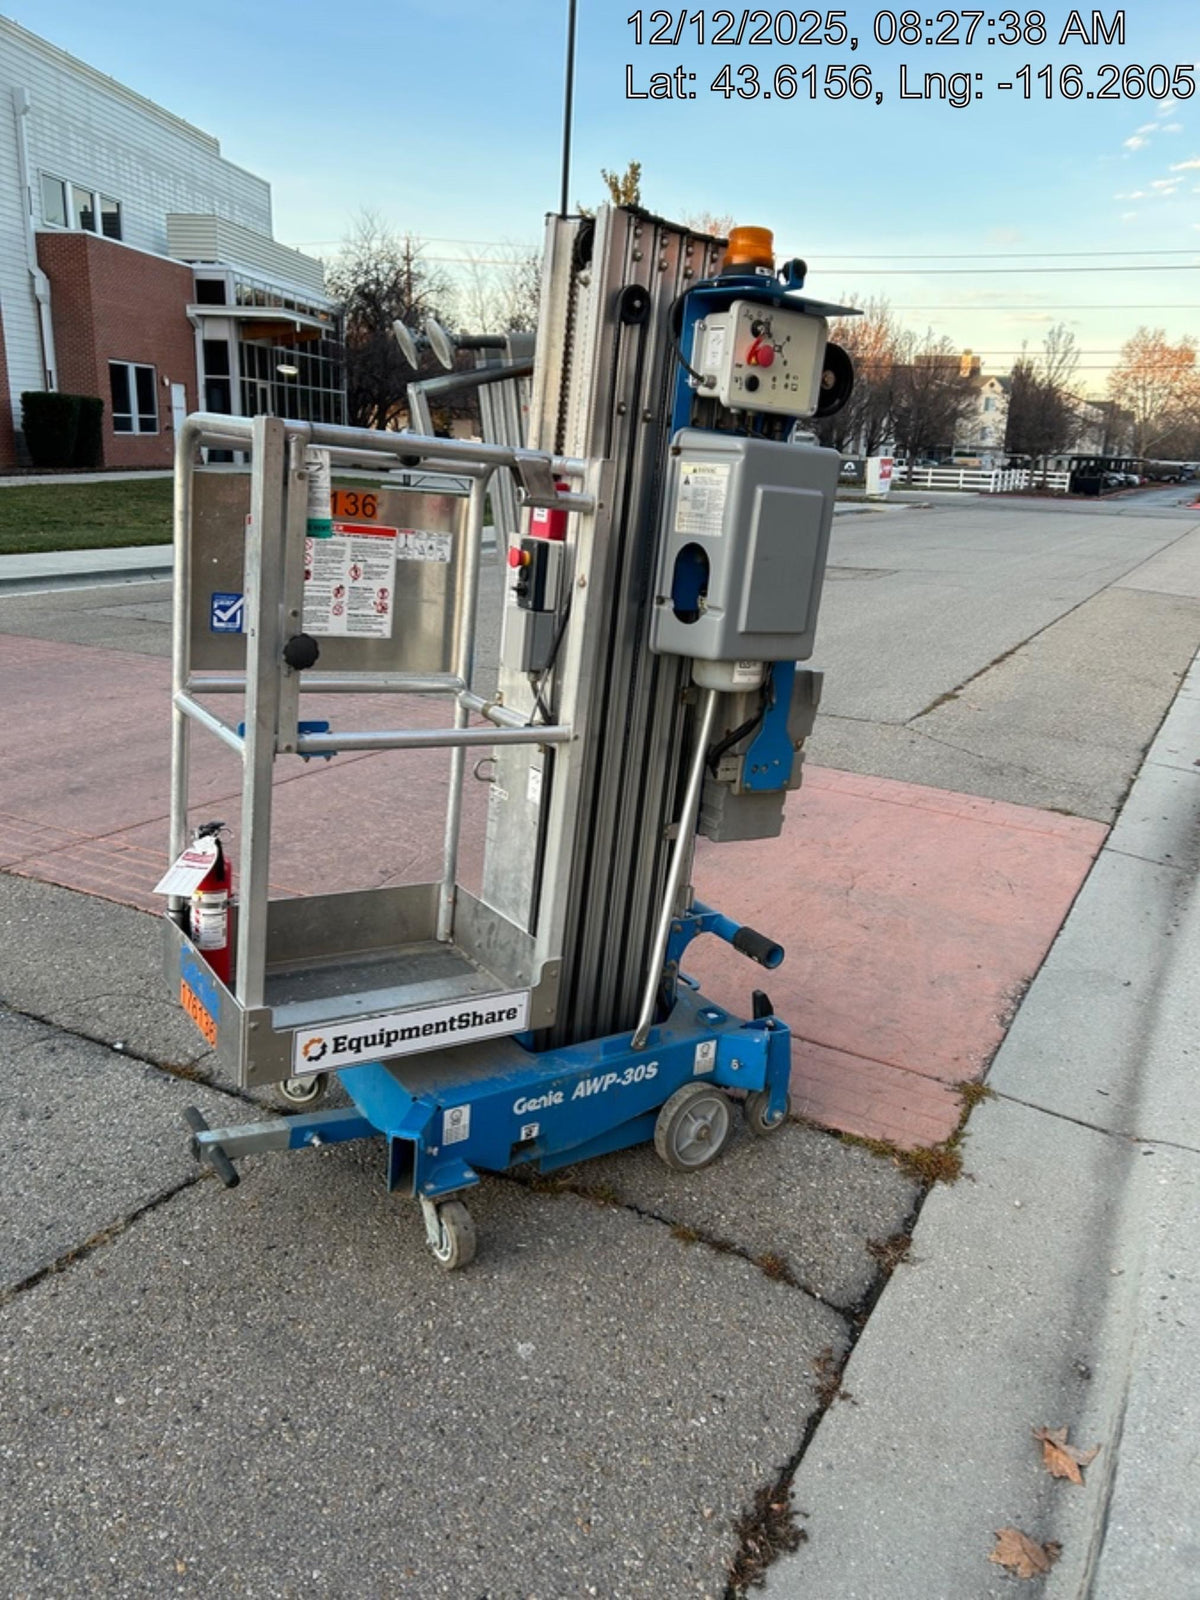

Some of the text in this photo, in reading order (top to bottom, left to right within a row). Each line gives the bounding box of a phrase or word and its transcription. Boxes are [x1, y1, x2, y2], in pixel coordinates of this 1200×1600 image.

[331, 1006, 518, 1055] EquipmentShare
[512, 1089, 565, 1116] Genie
[571, 1060, 660, 1101] AWP-30S
